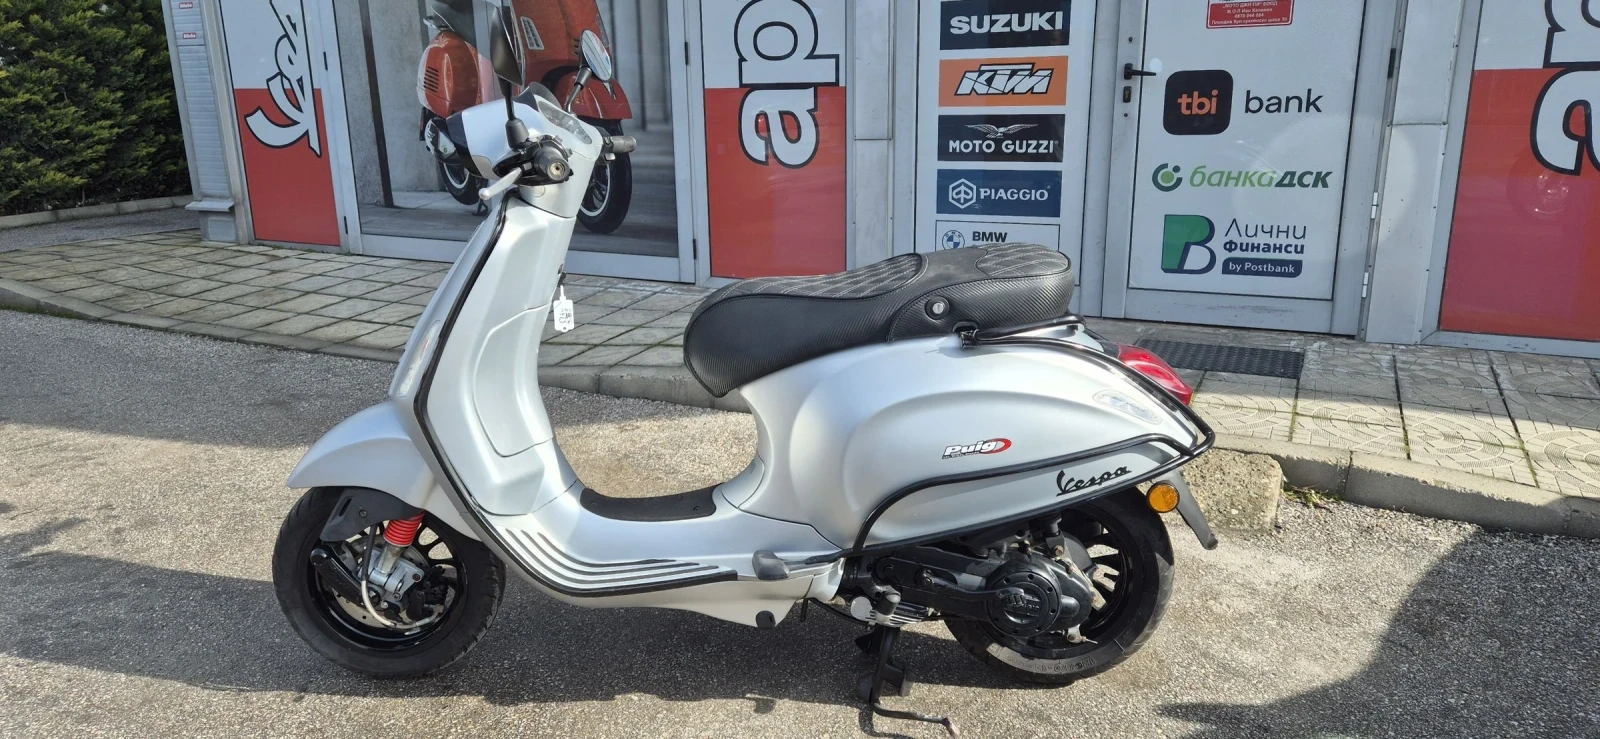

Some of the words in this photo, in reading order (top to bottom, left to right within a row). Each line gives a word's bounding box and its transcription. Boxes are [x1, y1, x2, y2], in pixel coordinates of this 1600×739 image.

[950, 11, 1063, 34] SUZUKI
[954, 63, 1054, 95] KTM
[1177, 89, 1219, 115] tbi
[1244, 88, 1323, 114] bank
[949, 140, 995, 153] MOTO
[1001, 140, 1054, 153] GUZZI
[980, 188, 1049, 201] PIAGGIO
[972, 231, 1008, 243] BMW
[1224, 218, 1307, 240] Лични
[1229, 261, 1242, 273] by
[1244, 262, 1295, 273] Postbank
[943, 440, 997, 456] Puig
[1056, 466, 1132, 497] Vespa
